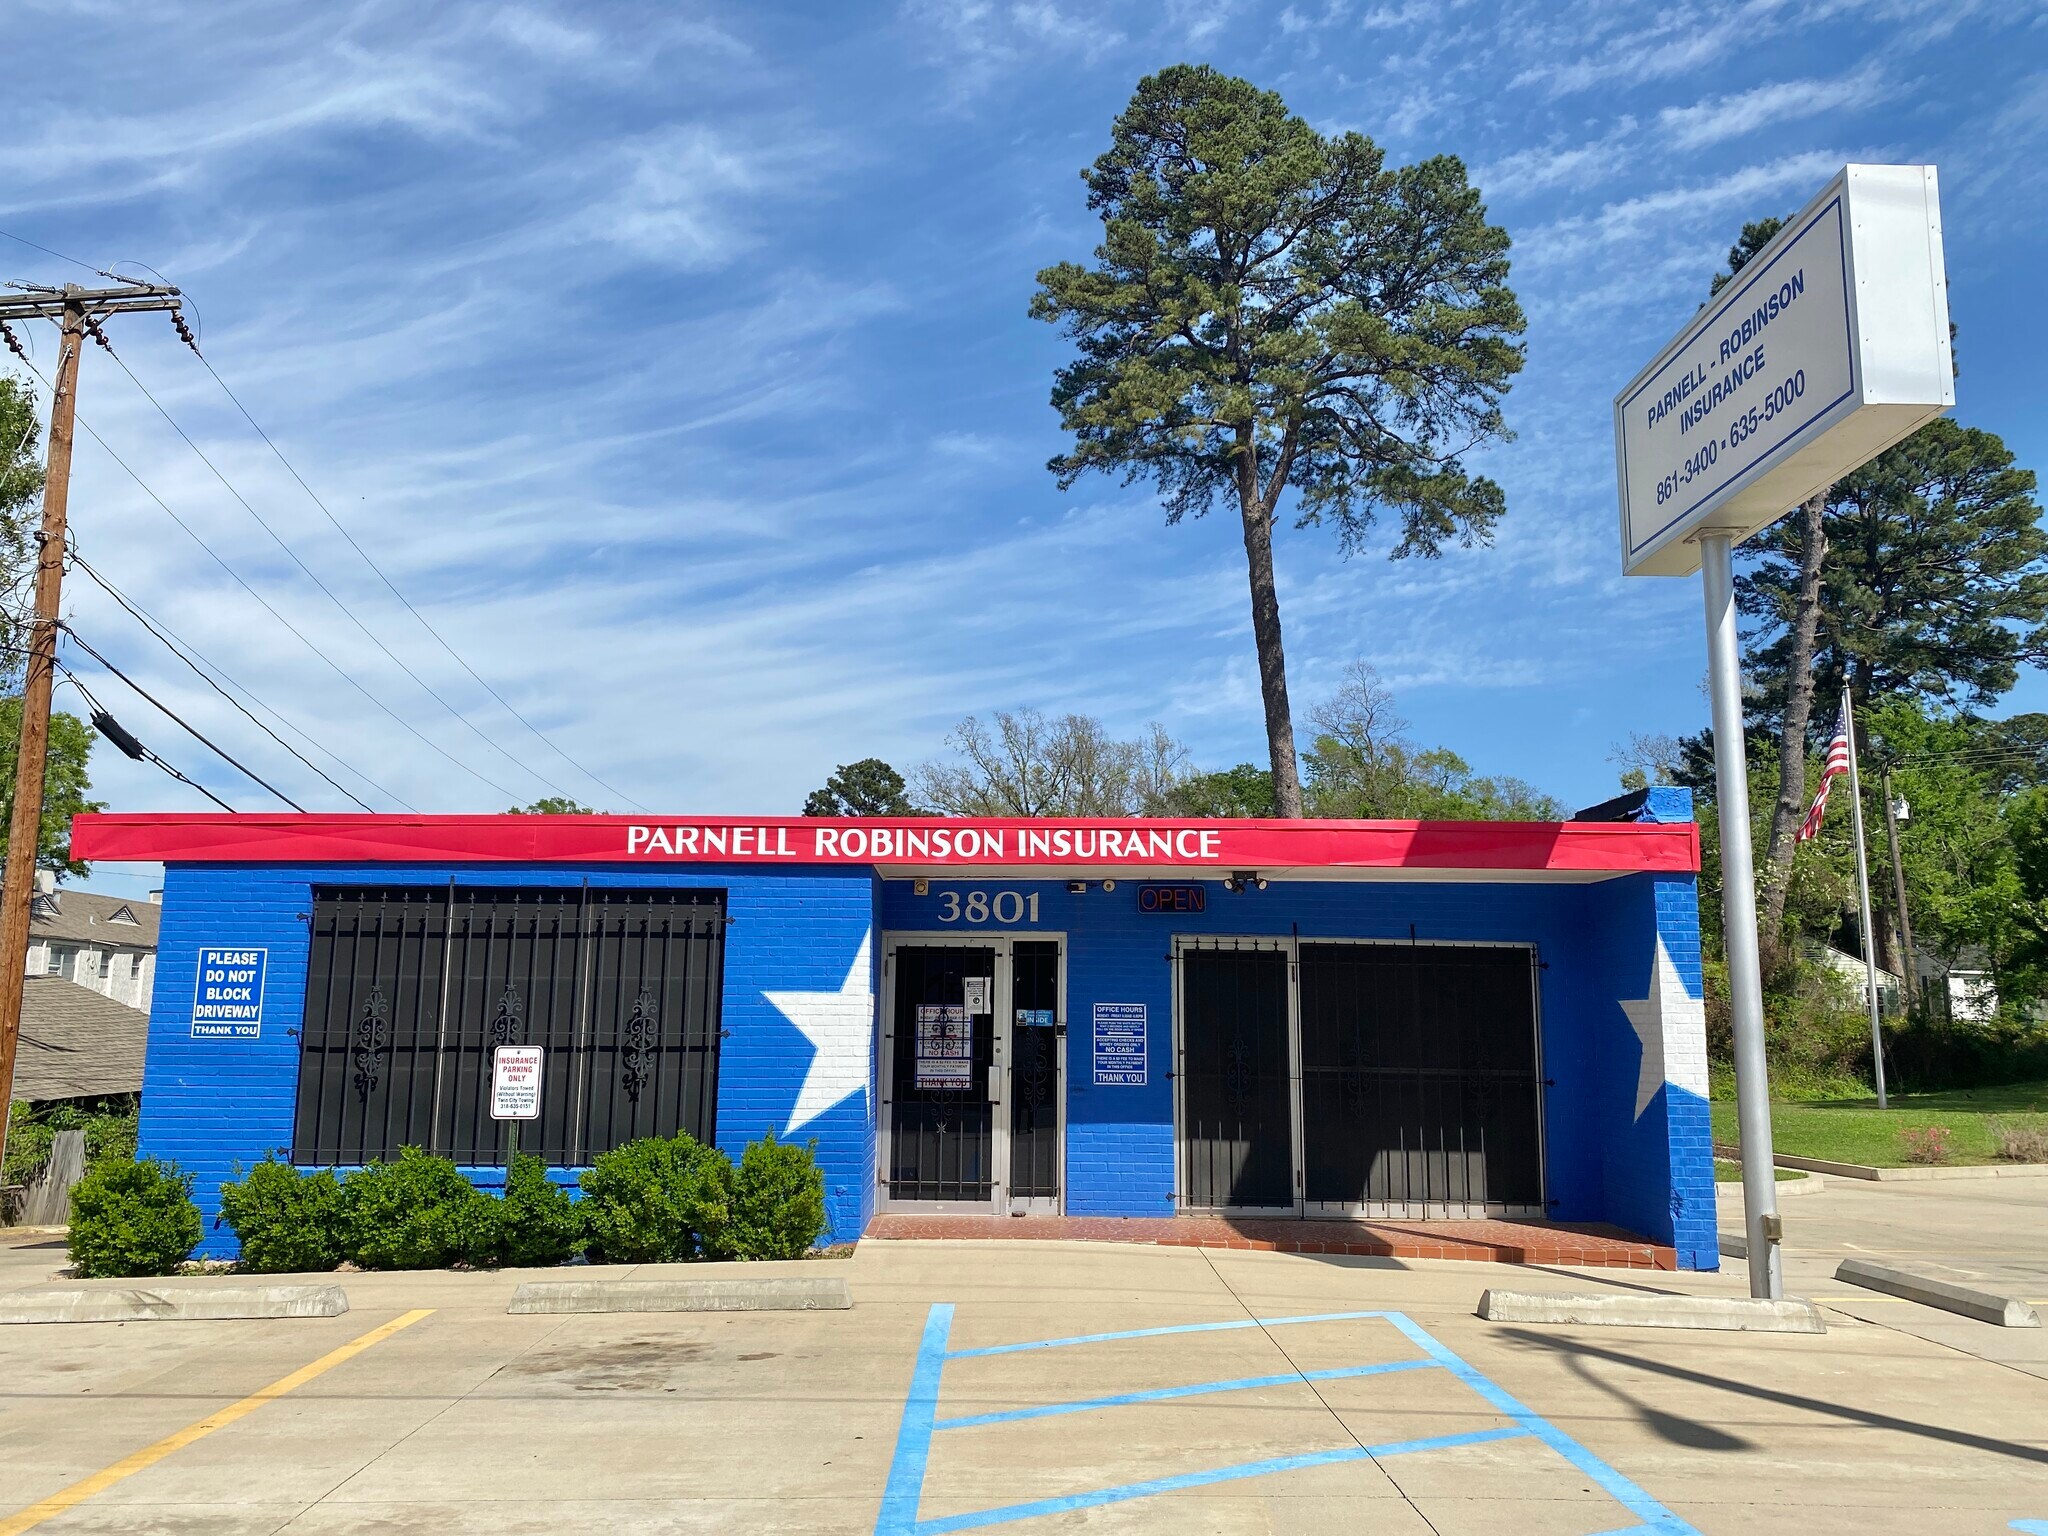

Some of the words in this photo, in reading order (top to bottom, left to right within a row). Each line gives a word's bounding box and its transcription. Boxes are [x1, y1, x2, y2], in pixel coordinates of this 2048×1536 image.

[1647, 363, 1707, 430] PARNELL
[1720, 269, 1805, 366] ROBINSON
[1679, 345, 1766, 435] INSURANCE
[1656, 439, 1718, 506] 861-3400
[1730, 369, 1806, 448] 635-5000
[627, 826, 796, 855] PARNELL
[815, 827, 1004, 859] ROBINSON
[1017, 829, 1221, 859] INSURANCE
[1141, 888, 1203, 911] OPEN
[937, 891, 1039, 923] 3801
[207, 952, 258, 965] PLEASE
[205, 970, 225, 983] DO
[228, 970, 256, 983] NOT
[206, 987, 252, 1000] BLOCK
[195, 1004, 259, 1018] DRIVEWAY
[194, 1026, 232, 1034] THANK
[235, 1026, 257, 1035] YOU
[920, 1078, 948, 1086] THANK
[949, 1078, 966, 1086] YOU
[1098, 1074, 1125, 1082] THANK
[1125, 1074, 1143, 1082] YOU
